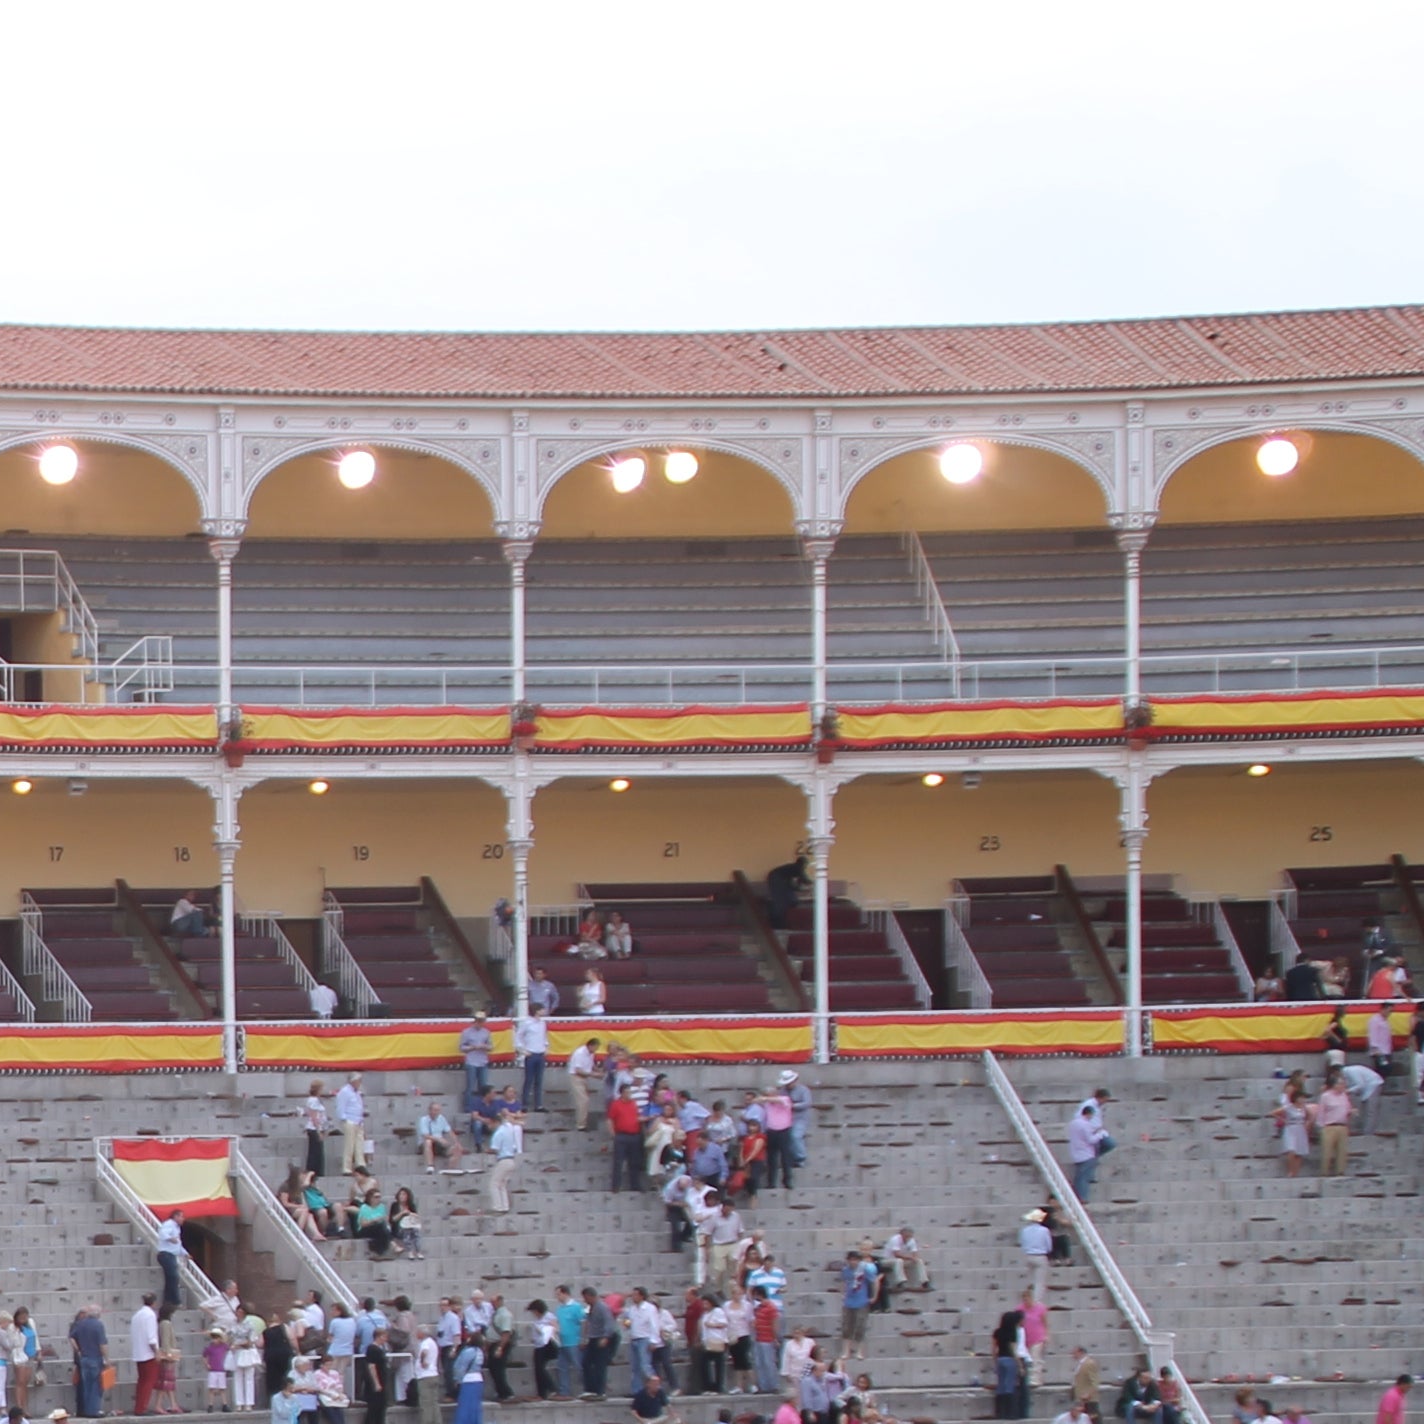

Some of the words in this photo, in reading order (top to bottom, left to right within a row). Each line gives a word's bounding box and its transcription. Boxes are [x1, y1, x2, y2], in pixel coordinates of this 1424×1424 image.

[1310, 826, 1333, 842] 25
[482, 844, 504, 860] 20
[662, 842, 680, 858] 21
[979, 836, 1001, 852] 23
[49, 846, 64, 862] 17
[174, 846, 191, 862] 18
[353, 845, 370, 861] 19
